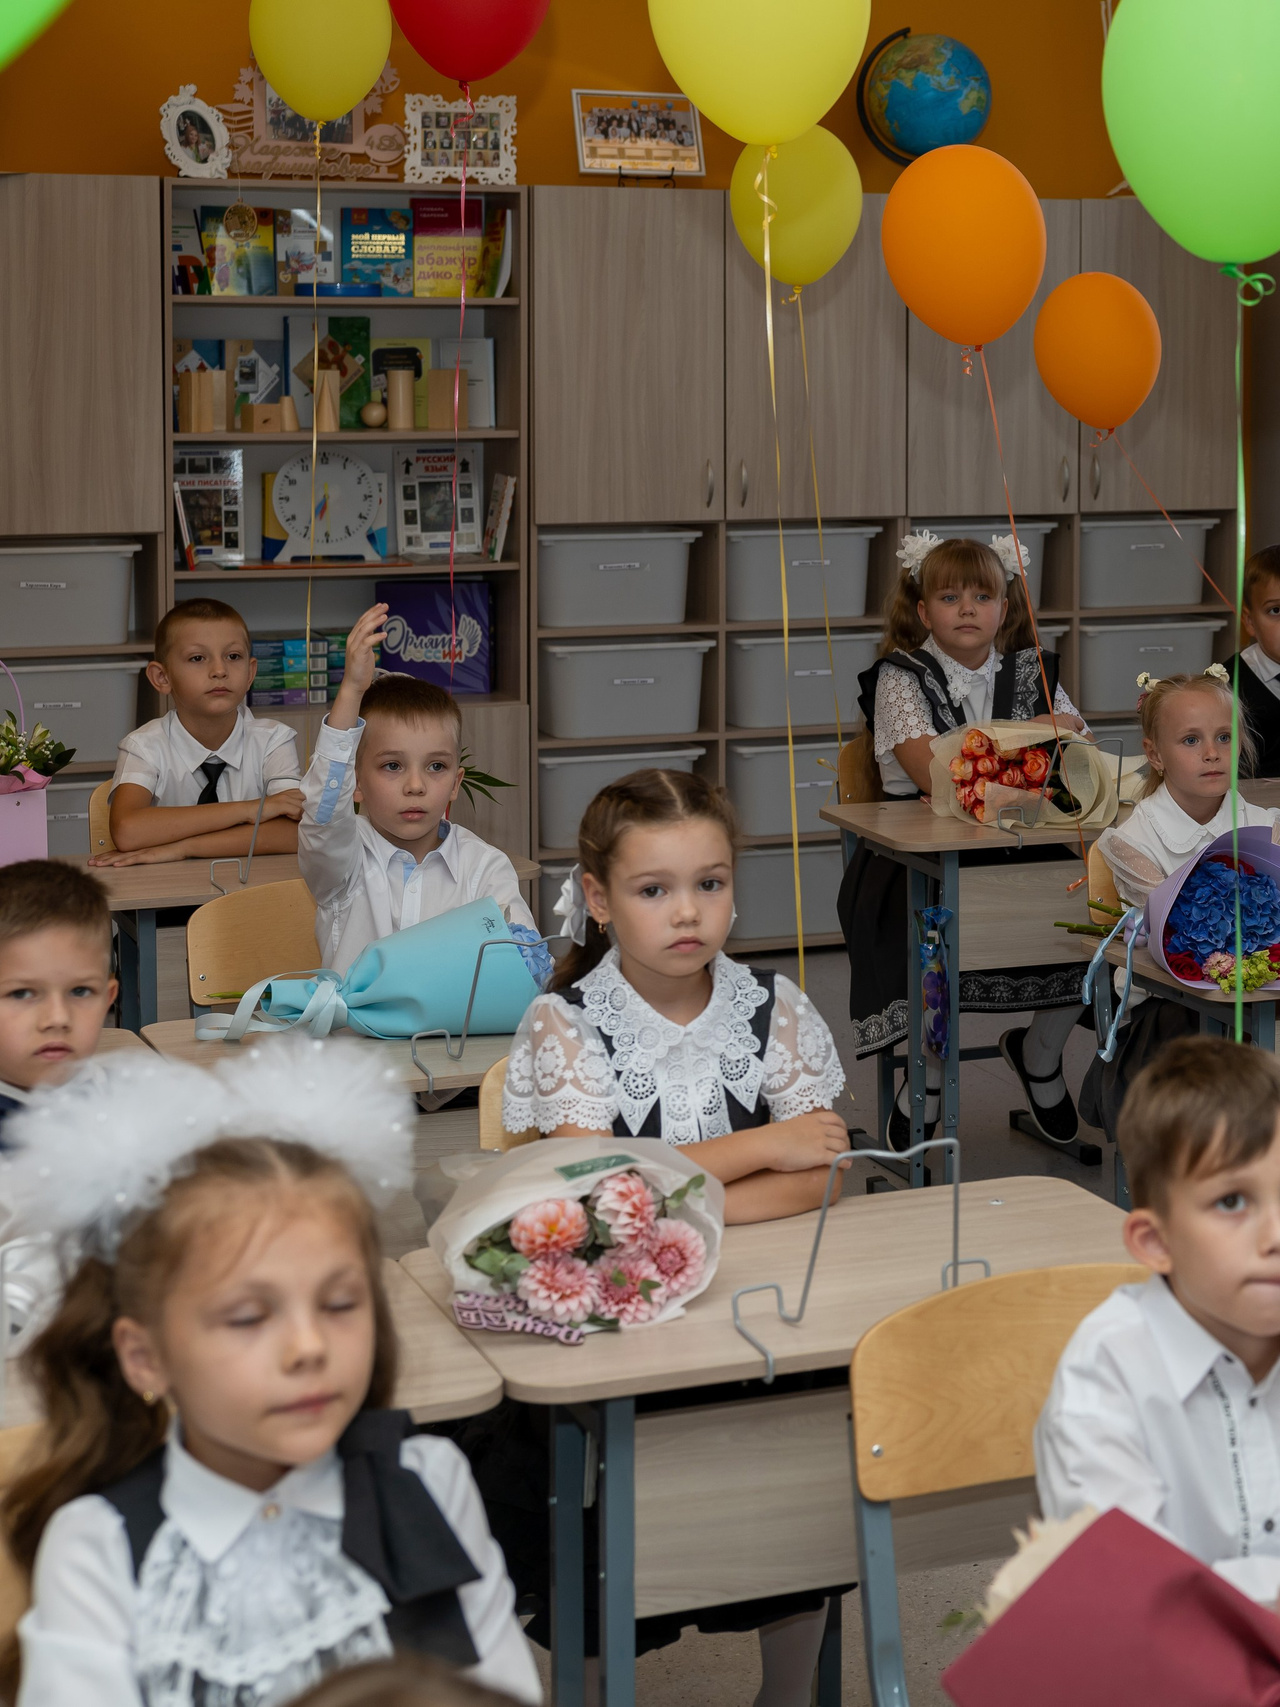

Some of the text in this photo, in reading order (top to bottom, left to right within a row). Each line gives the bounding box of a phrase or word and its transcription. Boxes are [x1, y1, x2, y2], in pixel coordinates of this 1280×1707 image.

[351, 232, 370, 241] МОЙ
[351, 245, 405, 254] СЛОВАРЬ
[320, 456, 329, 464] 12
[415, 453, 456, 463] РУССКИЙ
[424, 465, 449, 473] ЯЗЫК
[384, 617, 463, 655] Орлята
[405, 649, 463, 660] РОССИИ
